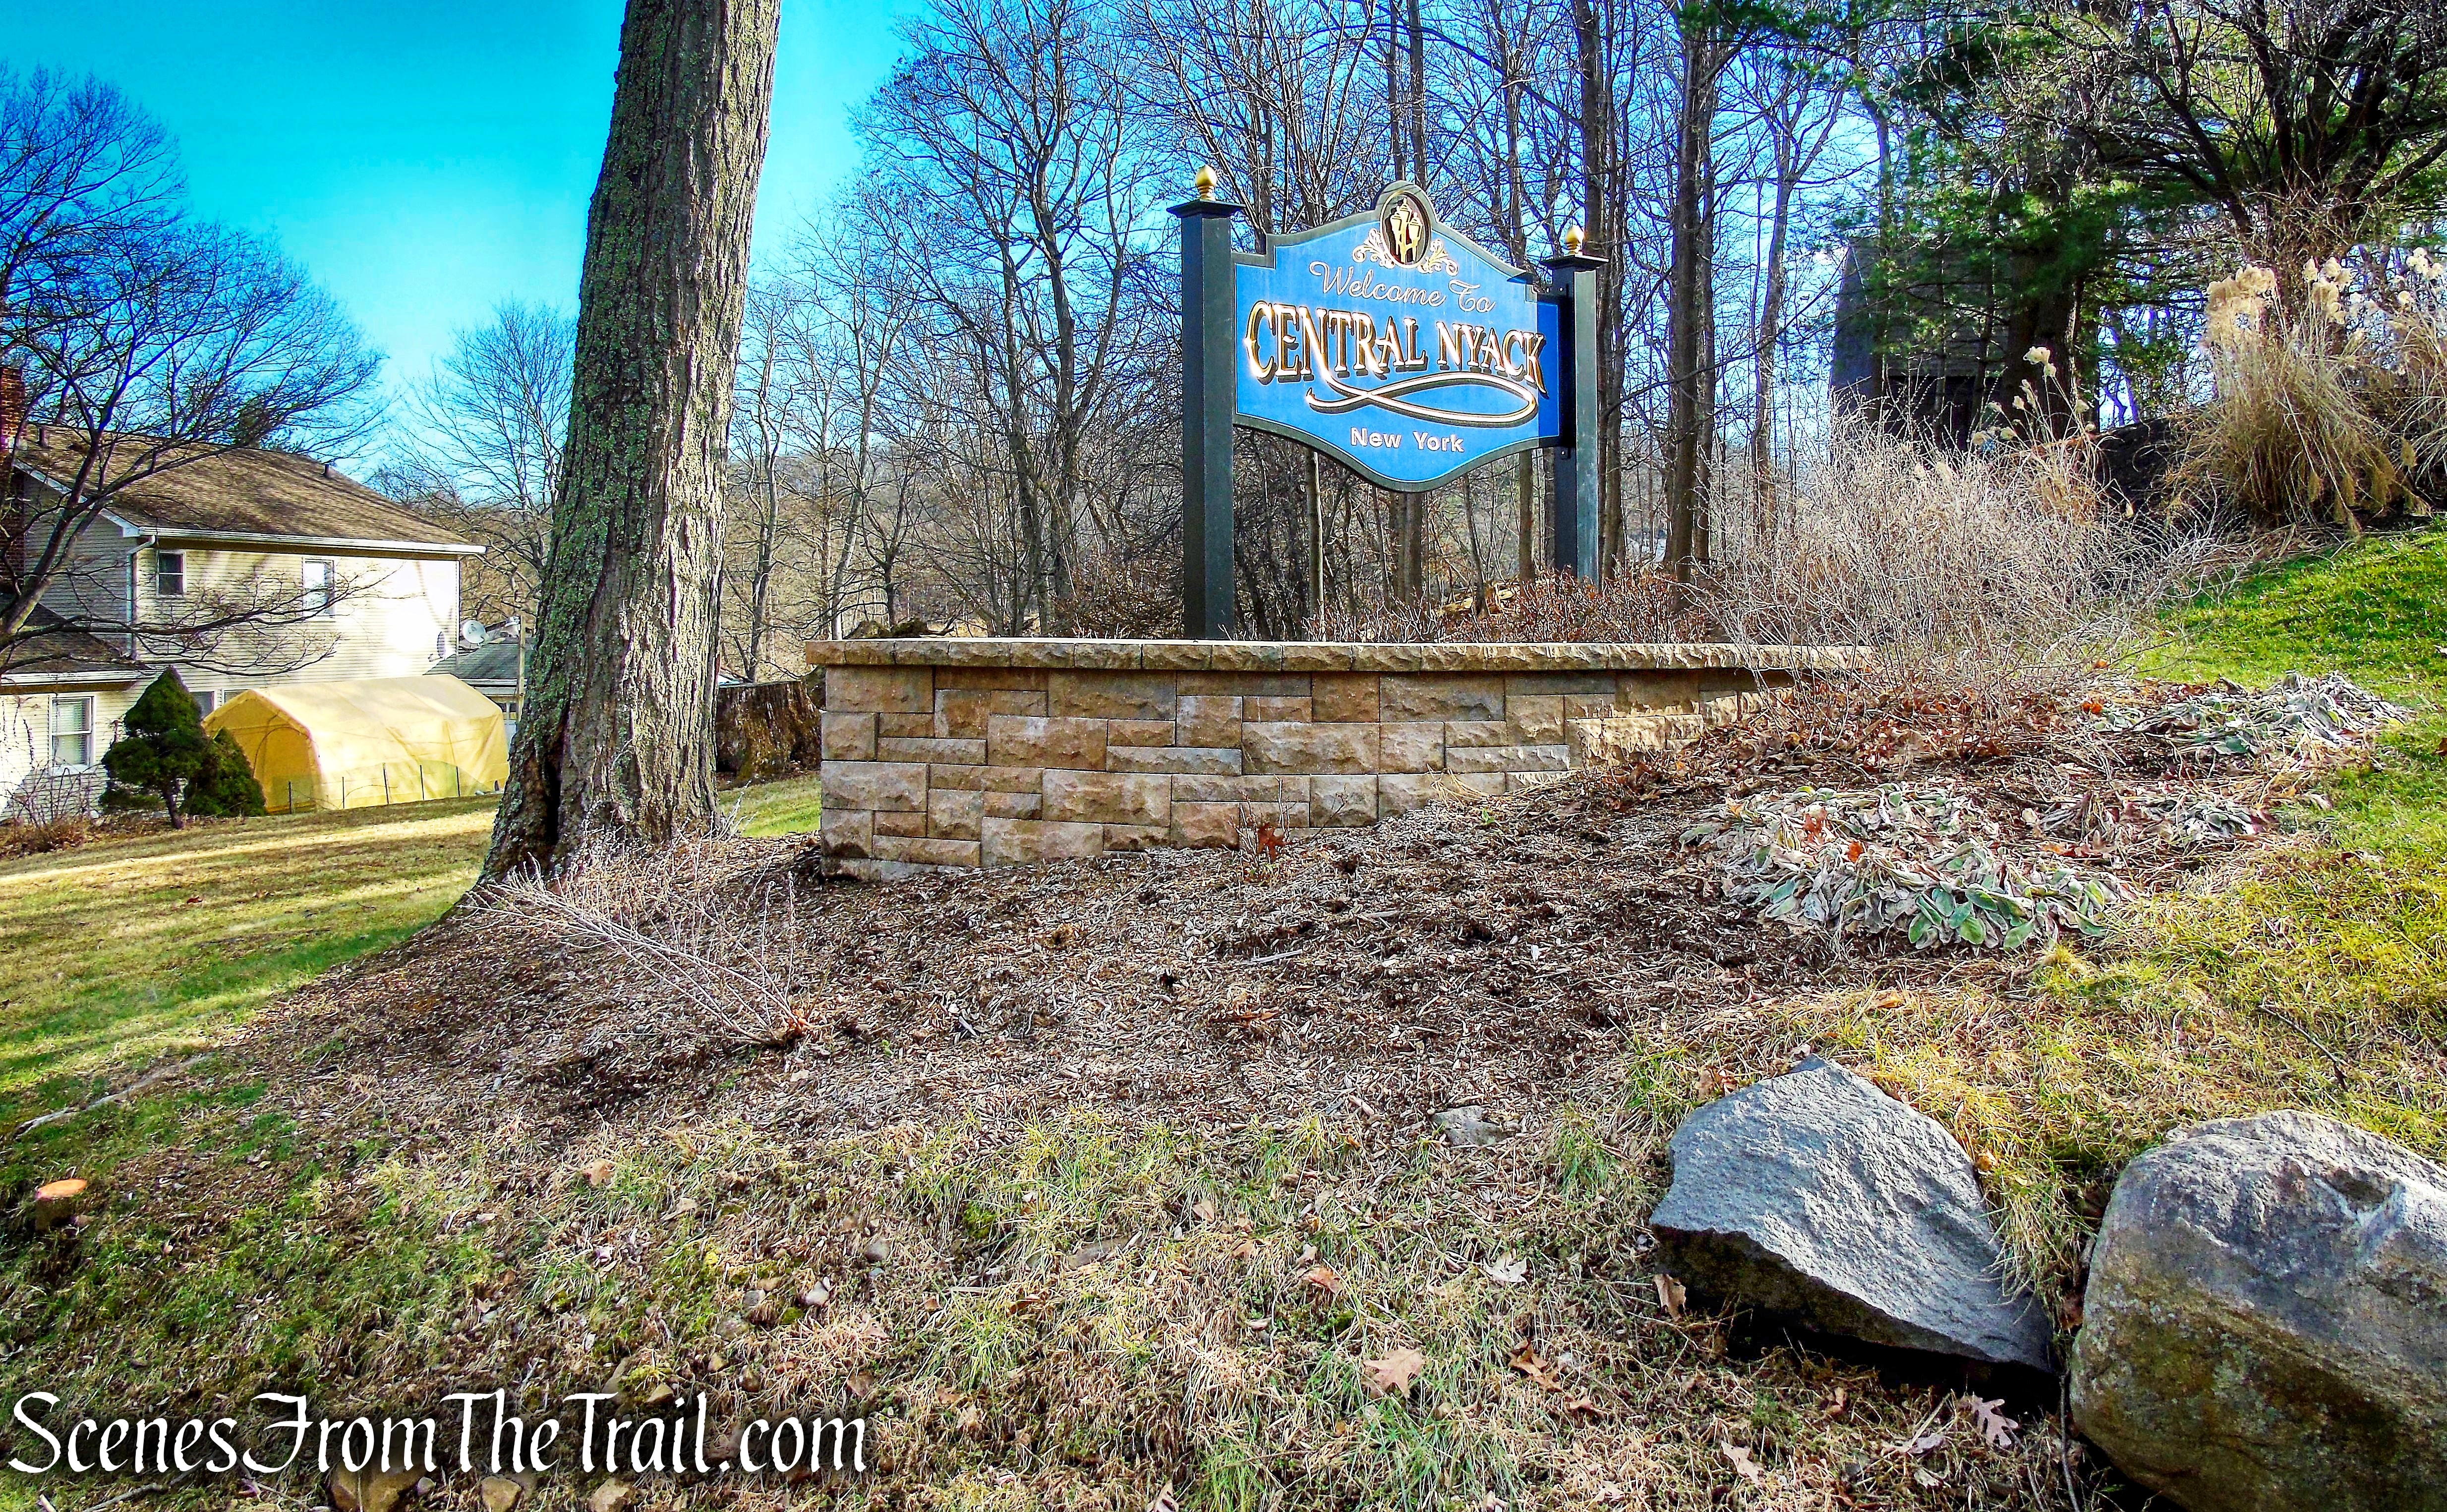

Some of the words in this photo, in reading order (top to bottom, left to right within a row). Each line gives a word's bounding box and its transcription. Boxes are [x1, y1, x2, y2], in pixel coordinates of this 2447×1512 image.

[1309, 261, 1447, 306] Welcome
[1449, 279, 1496, 313] To
[1244, 300, 1428, 382] CENTRAL
[1436, 321, 1548, 395] NYACK
[1350, 427, 1402, 449] New
[1413, 432, 1464, 453] York
